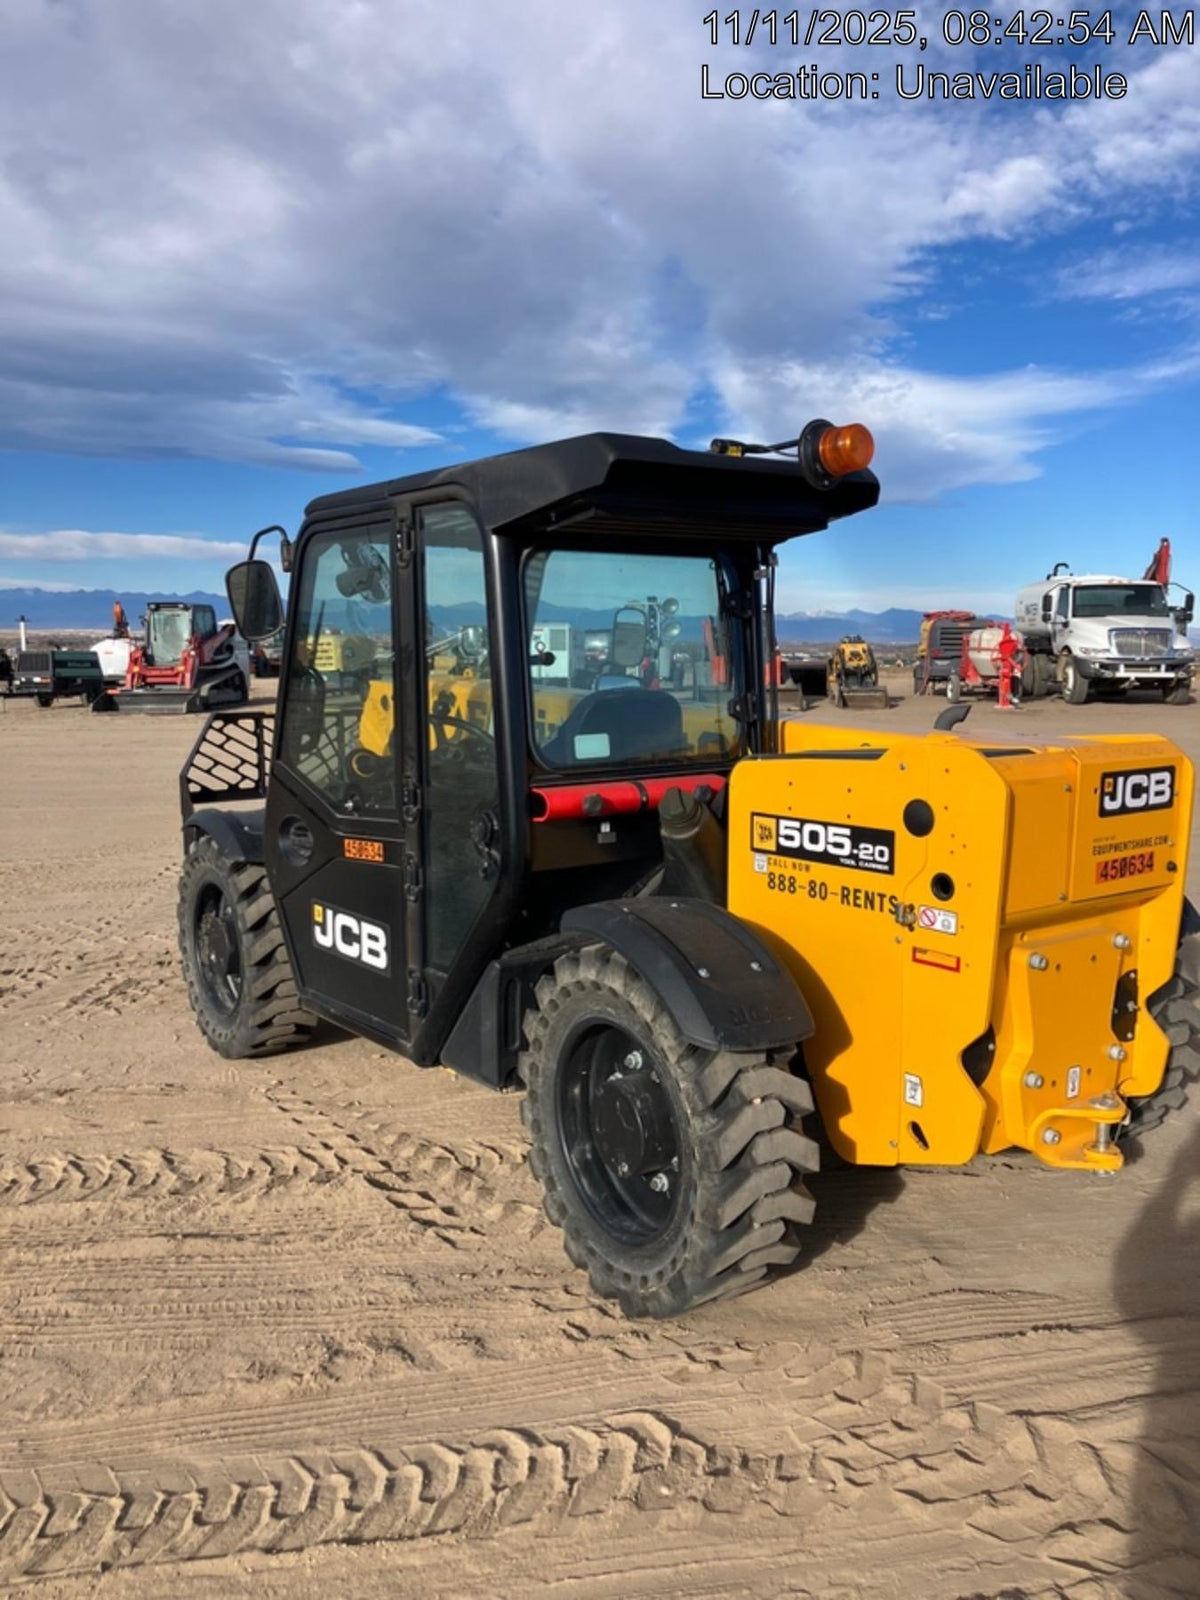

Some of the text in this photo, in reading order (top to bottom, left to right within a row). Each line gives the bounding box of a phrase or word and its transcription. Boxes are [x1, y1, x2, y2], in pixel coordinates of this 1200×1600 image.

[1103, 771, 1172, 810] JCB
[1100, 851, 1154, 881] 450634
[767, 872, 898, 915] 888-80-RENTS
[314, 907, 388, 970] JCB
